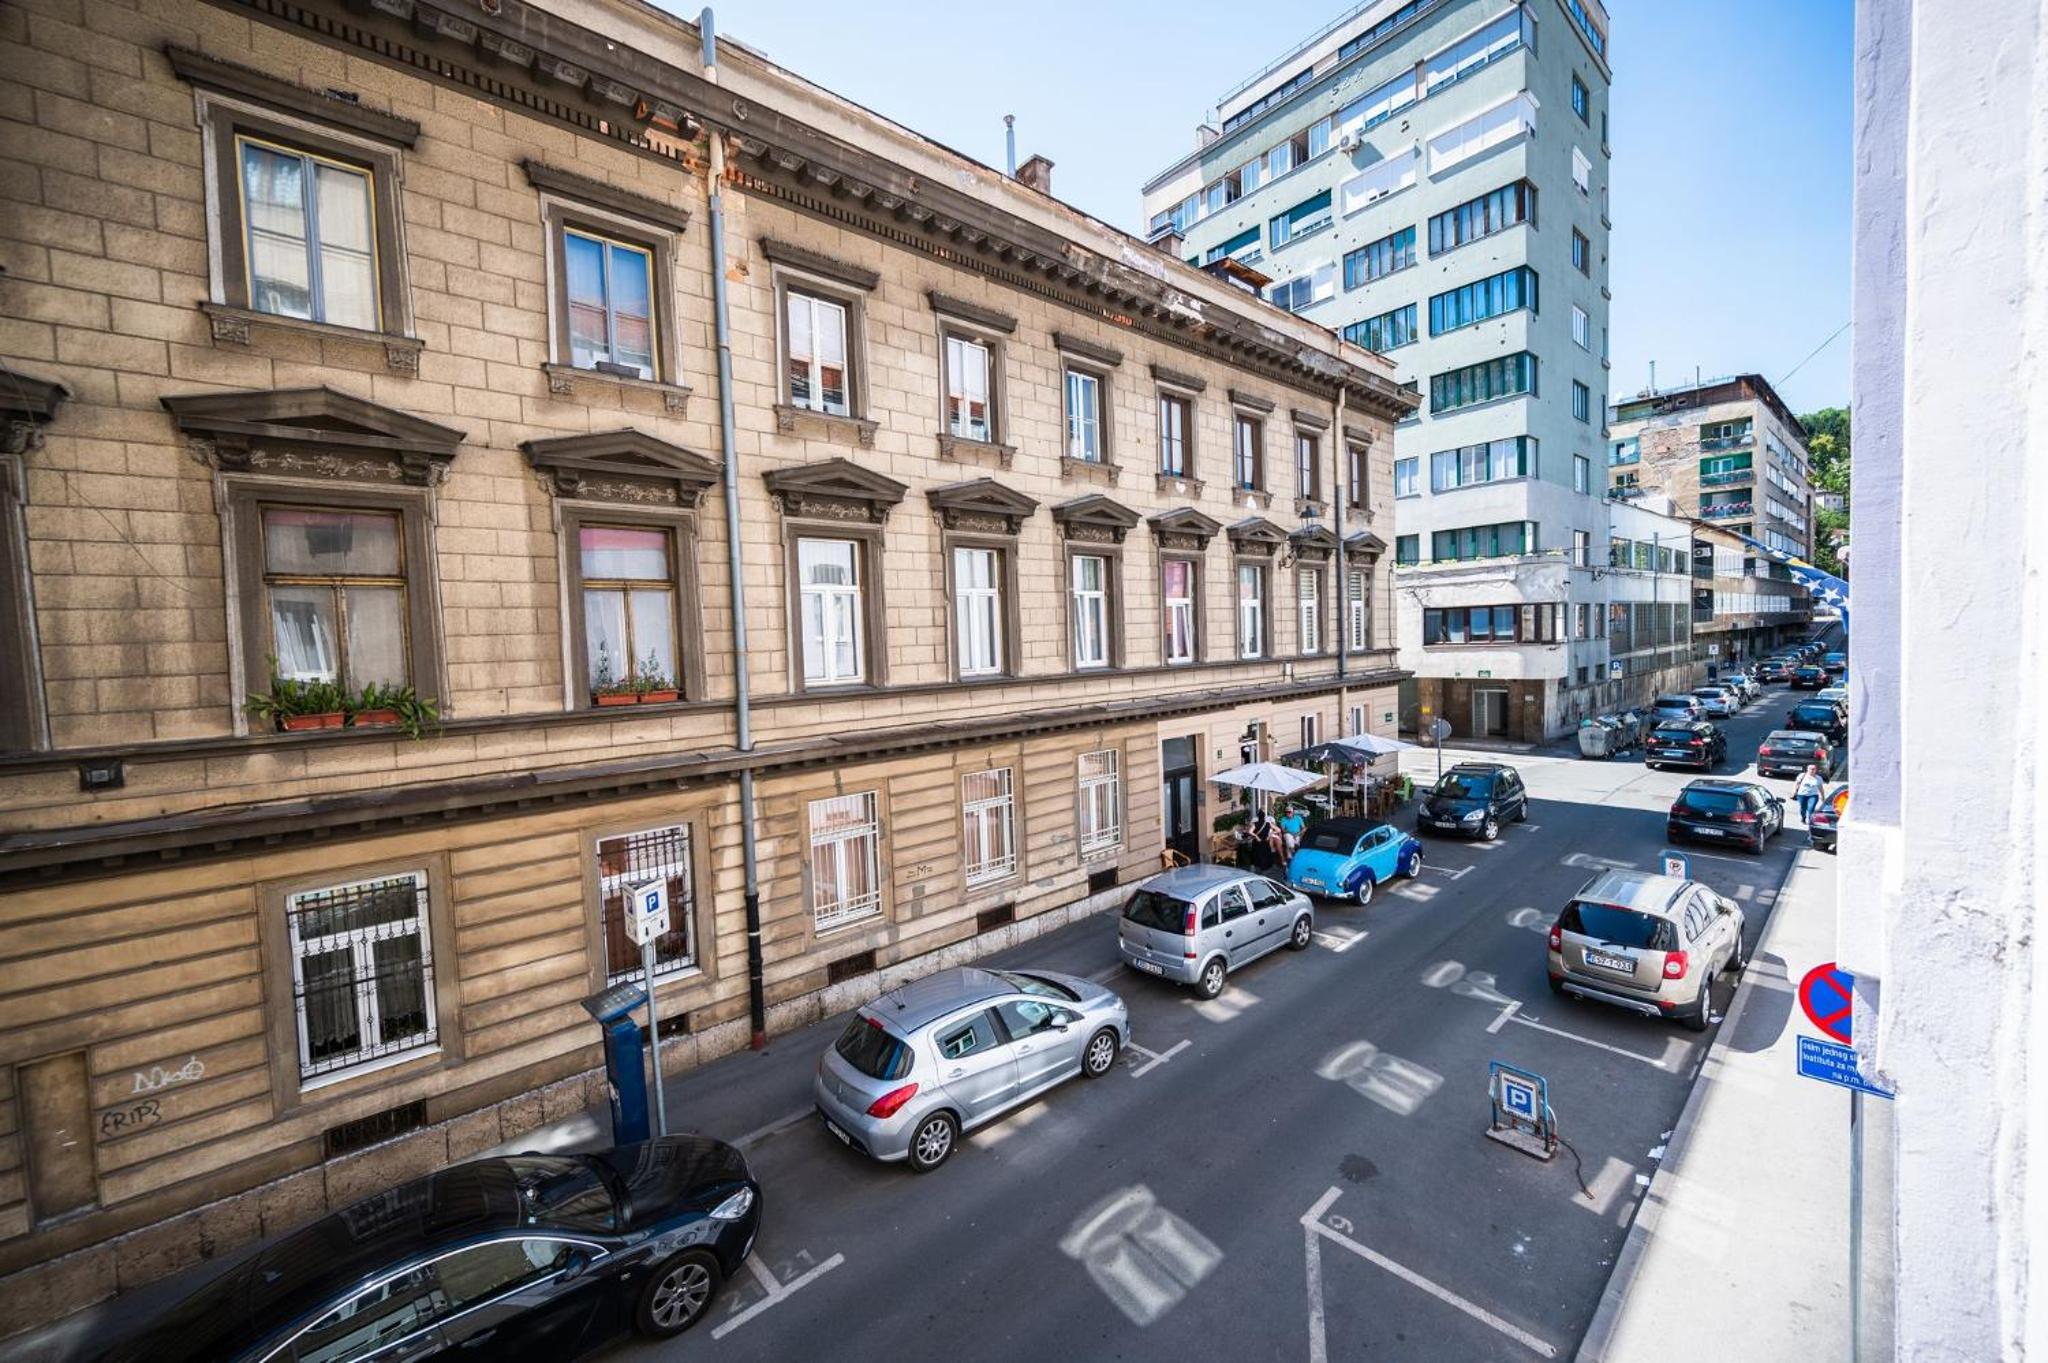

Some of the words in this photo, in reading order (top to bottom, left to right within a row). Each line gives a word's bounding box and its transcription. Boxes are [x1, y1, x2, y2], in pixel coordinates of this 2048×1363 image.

[648, 895, 656, 909] P
[1836, 1062, 1847, 1070] za
[1511, 1088, 1527, 1105] P
